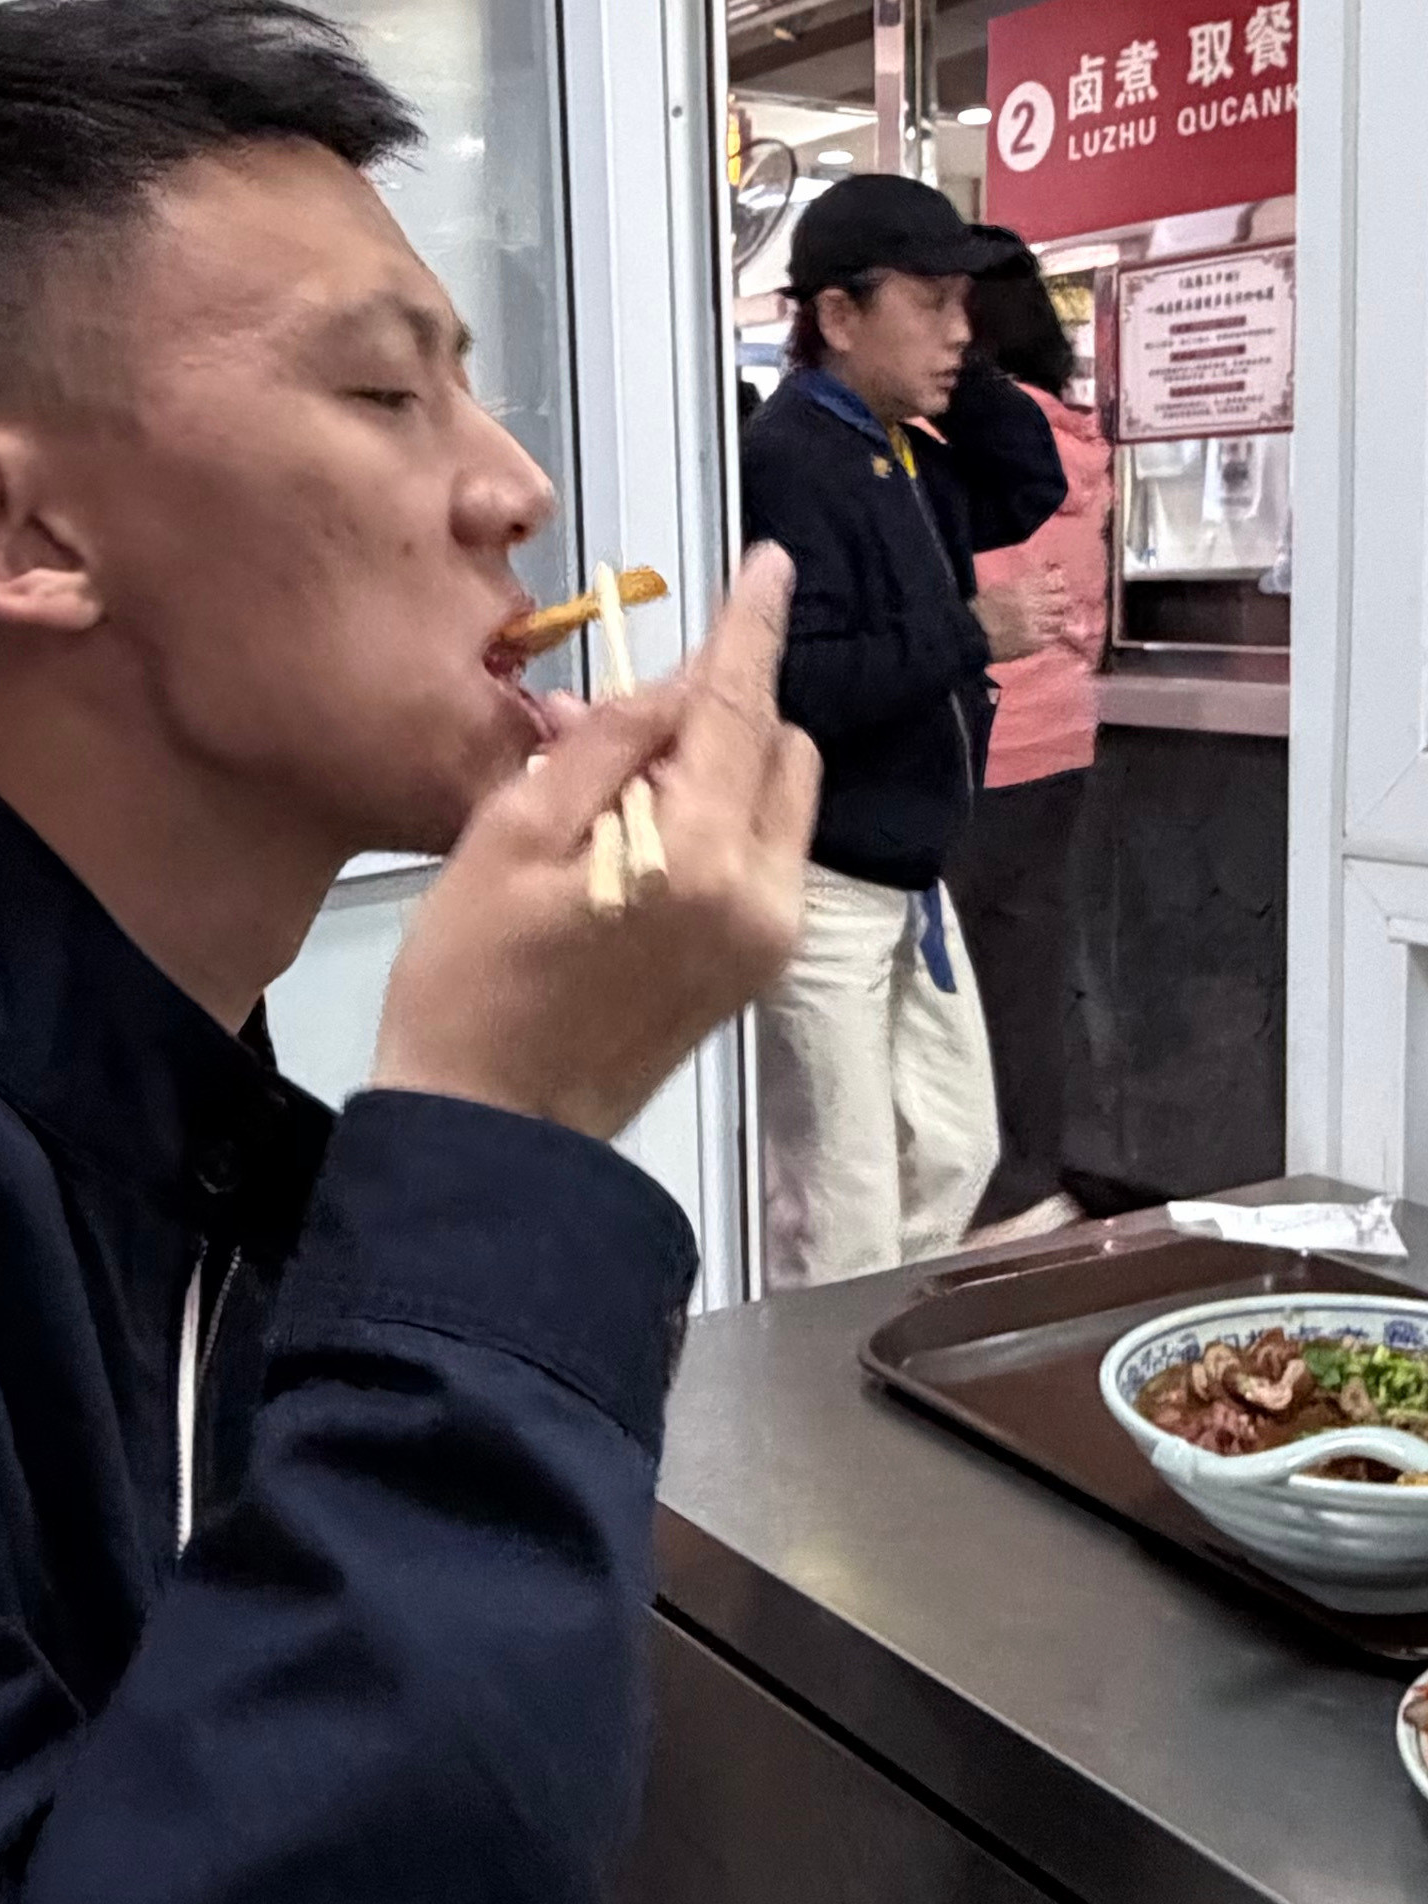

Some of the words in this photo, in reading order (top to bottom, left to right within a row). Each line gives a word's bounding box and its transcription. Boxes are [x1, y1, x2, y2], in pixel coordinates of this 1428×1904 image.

[1067, 38, 1160, 121] 卤煮
[1186, 0, 1293, 88] 取餐
[1009, 100, 1037, 156] 2
[1067, 115, 1158, 161] LUZHU
